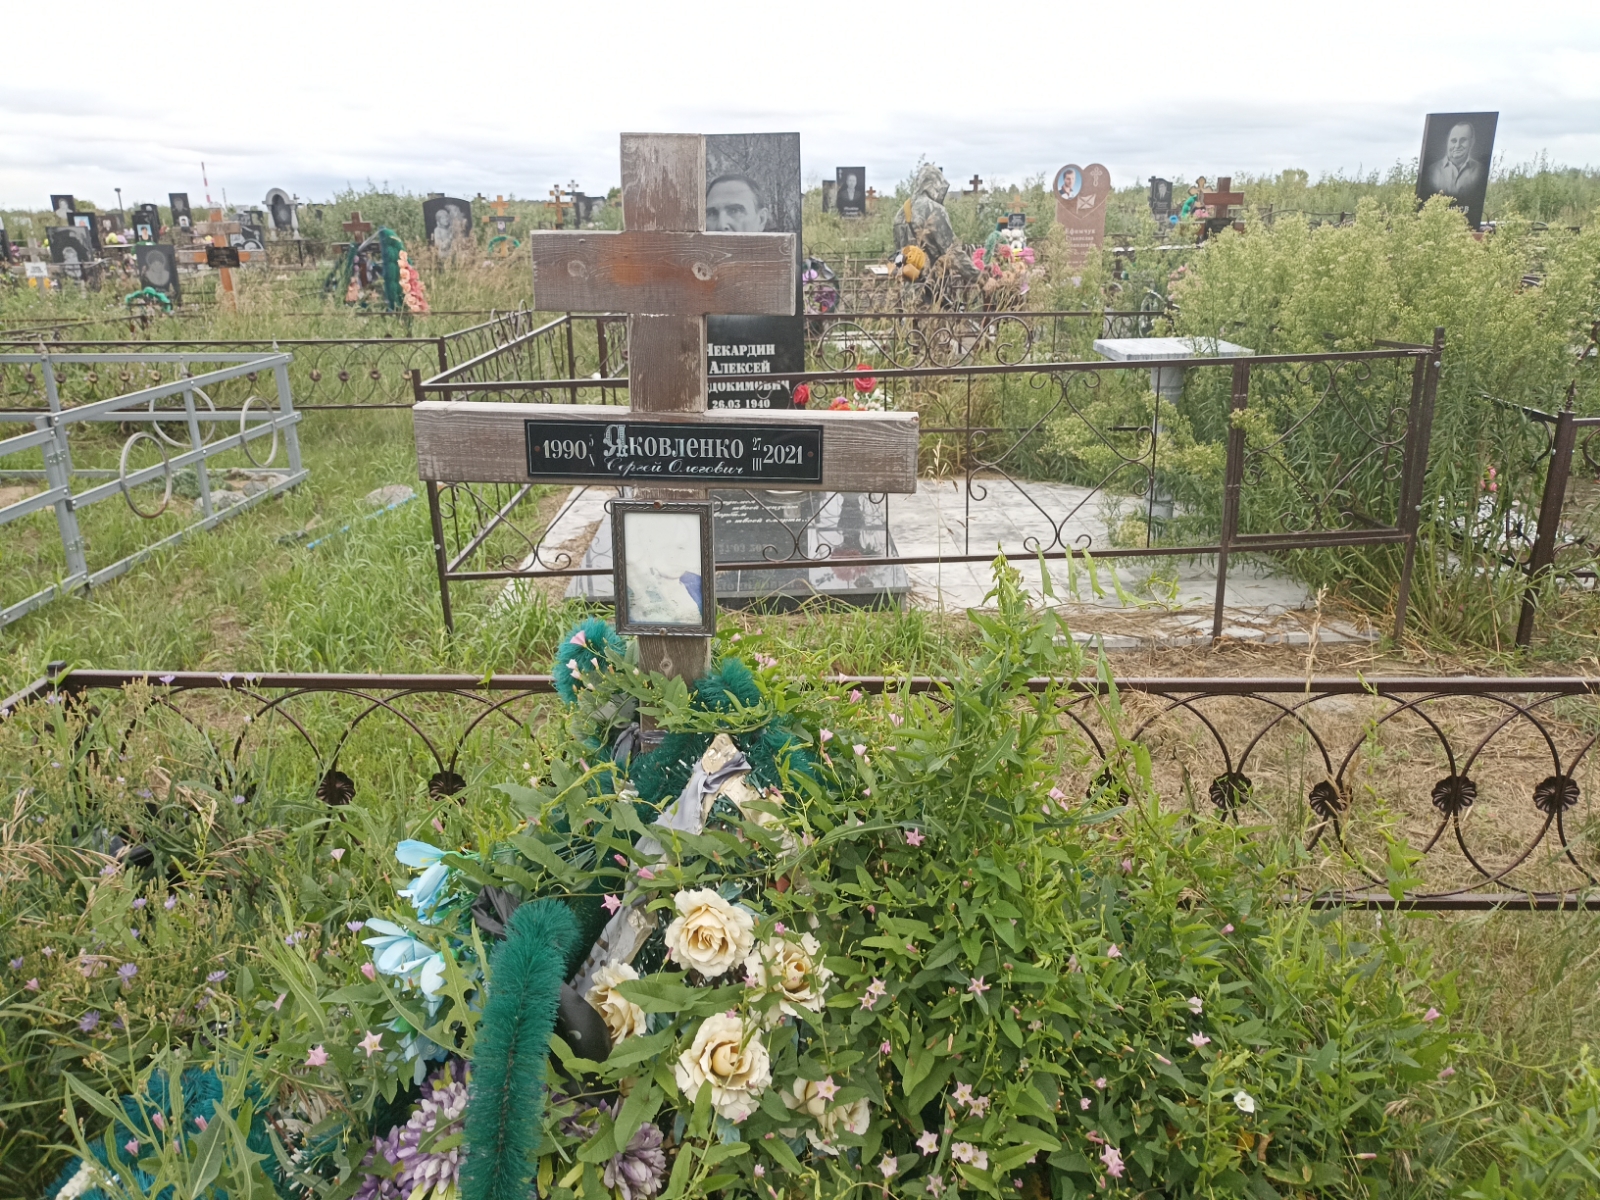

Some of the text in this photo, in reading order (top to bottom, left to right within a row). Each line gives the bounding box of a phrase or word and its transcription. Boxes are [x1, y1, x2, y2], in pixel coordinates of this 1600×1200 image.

[709, 360, 771, 374] АЛЕКСЕЙ
[745, 399, 771, 409] 1940
[543, 440, 587, 459] 1990
[603, 424, 744, 458] Яковленко
[752, 437, 762, 451] 27
[763, 444, 803, 464] 2021
[603, 457, 662, 477] Сергей
[668, 459, 744, 474] Олегович
